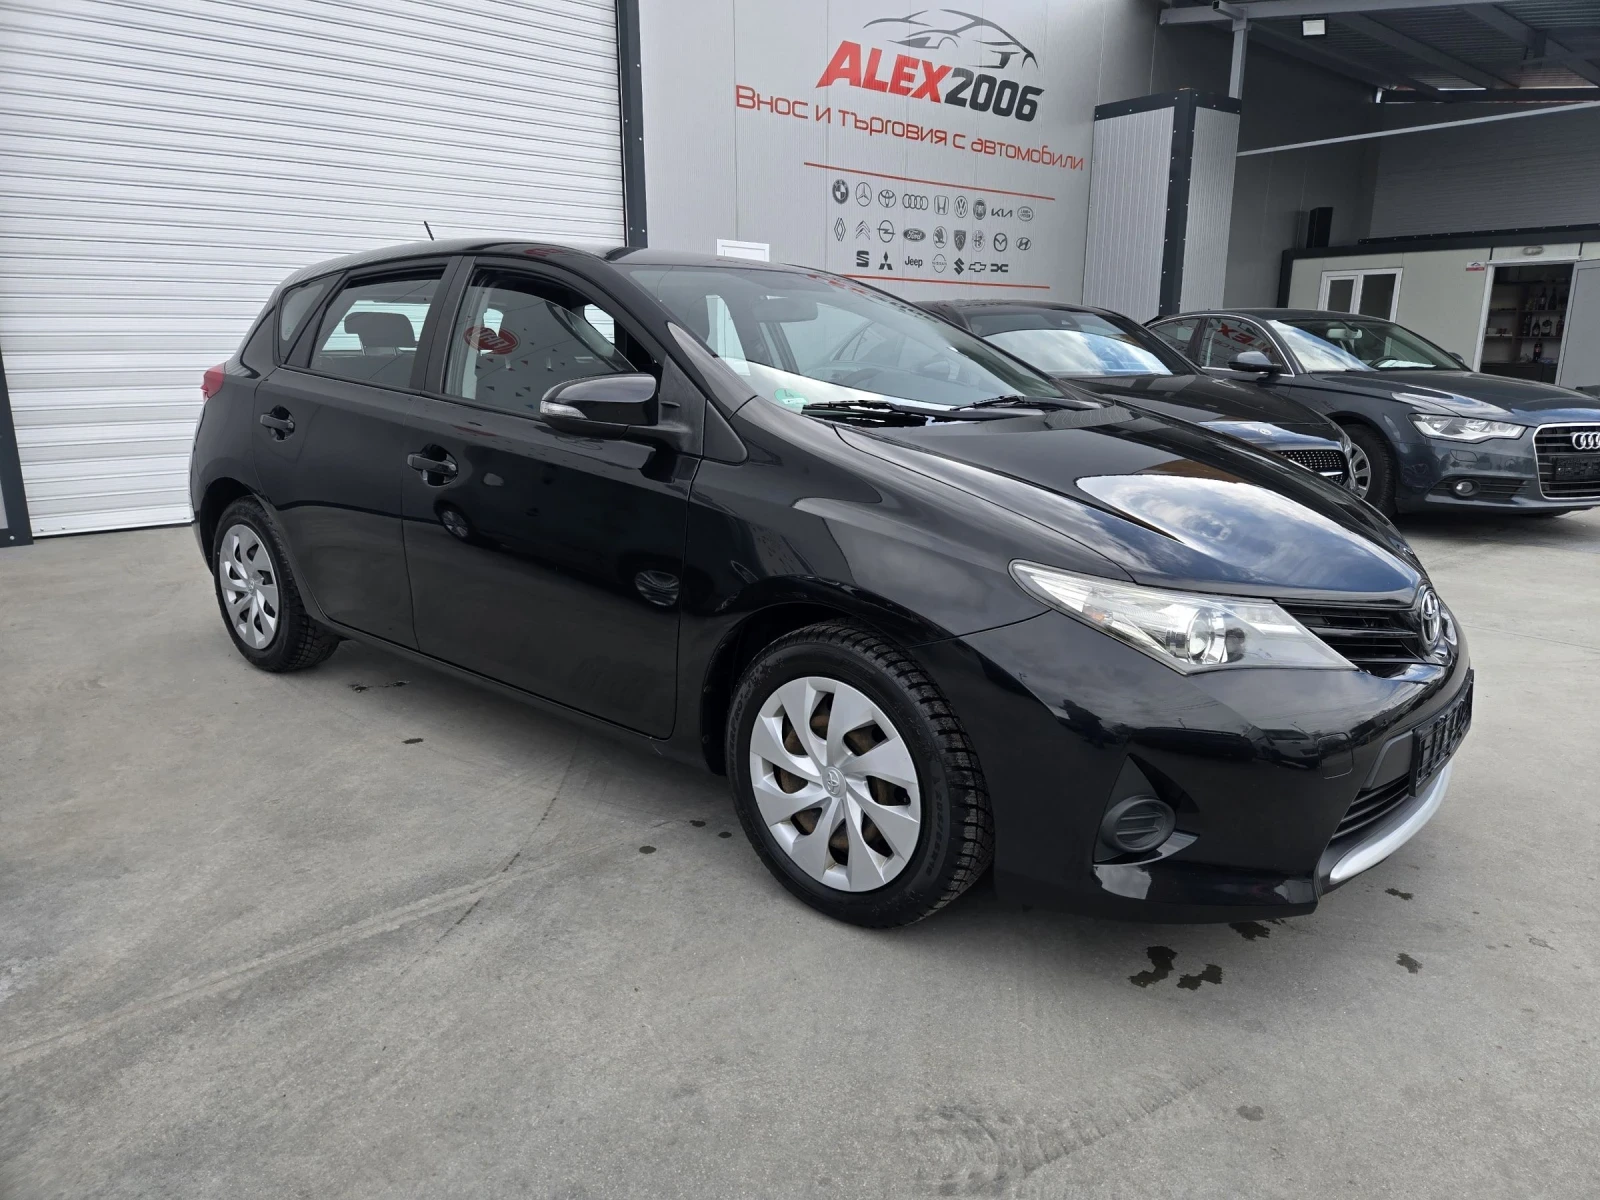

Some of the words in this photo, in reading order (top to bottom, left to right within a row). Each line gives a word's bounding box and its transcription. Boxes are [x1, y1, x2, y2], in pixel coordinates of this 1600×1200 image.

[736, 85, 809, 119] Внос
[815, 105, 832, 124] и
[838, 109, 947, 146] търговия
[971, 138, 1084, 171] автомобили
[905, 256, 923, 268] Jeep
